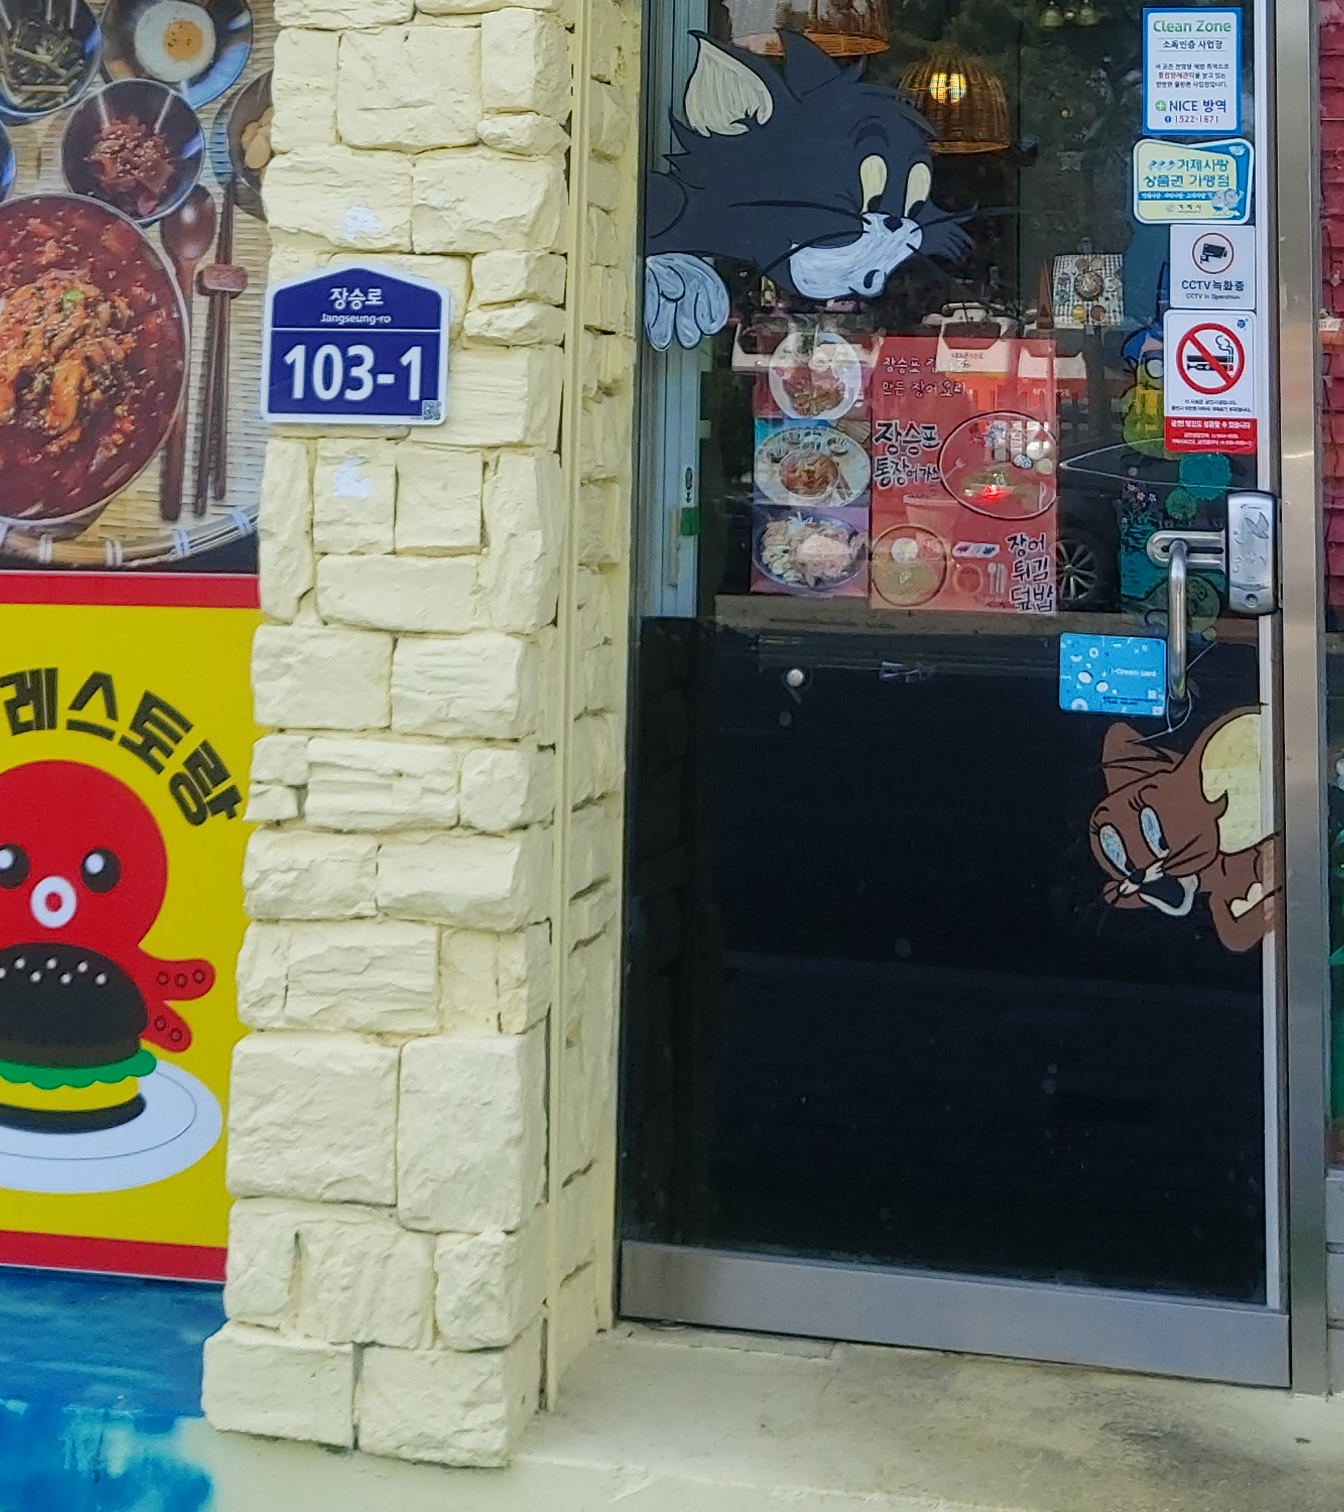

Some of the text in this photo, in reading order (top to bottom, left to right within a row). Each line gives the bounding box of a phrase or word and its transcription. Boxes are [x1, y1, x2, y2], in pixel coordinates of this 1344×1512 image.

[1153, 20, 1232, 32] Clean Zone
[1169, 99, 1226, 113] NICE 방역
[1175, 115, 1219, 123] 1522-1871
[1178, 159, 1229, 172] 거제사랑
[1144, 174, 1230, 188] 상품권 가맹점
[1181, 281, 1211, 290] CCTV
[329, 287, 384, 310] 장승로
[320, 313, 392, 325] Jangseung-ro
[283, 344, 422, 401] 103-1
[876, 420, 941, 456] 장승포
[1007, 533, 1047, 556] 장어
[1010, 558, 1049, 580] 튀김
[1010, 585, 1055, 613] 덮밥
